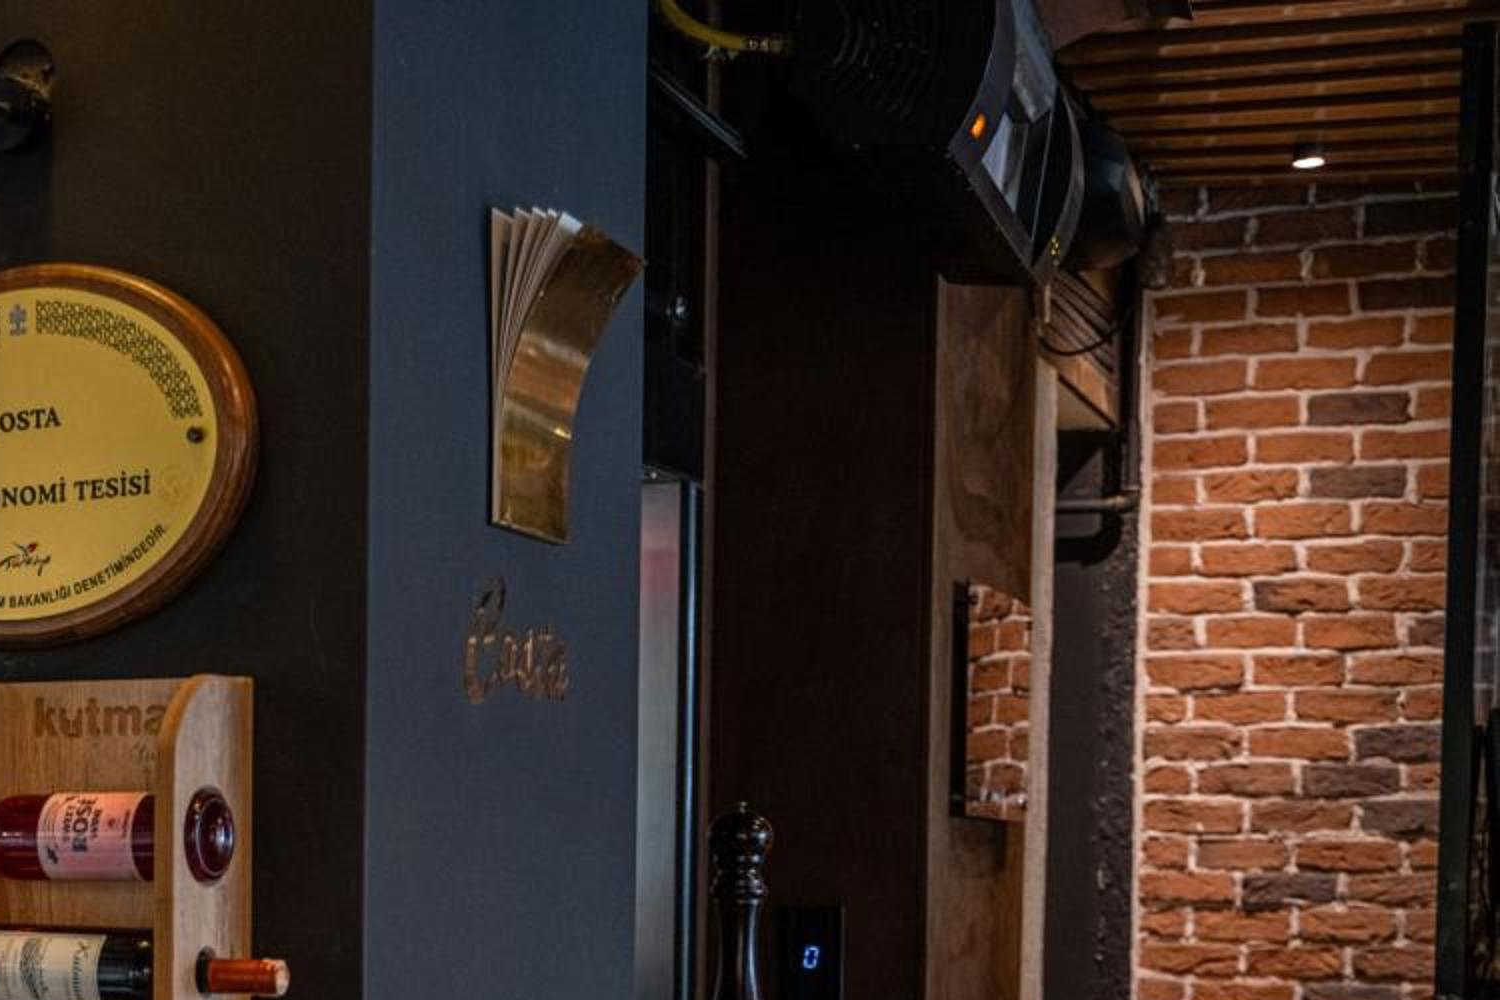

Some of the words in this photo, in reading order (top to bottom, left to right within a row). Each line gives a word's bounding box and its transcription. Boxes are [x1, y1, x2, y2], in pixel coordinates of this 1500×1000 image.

[73, 469, 151, 501] TESİSİ
[9, 585, 71, 609] BAKANLIĞI
[803, 945, 820, 969] 0
